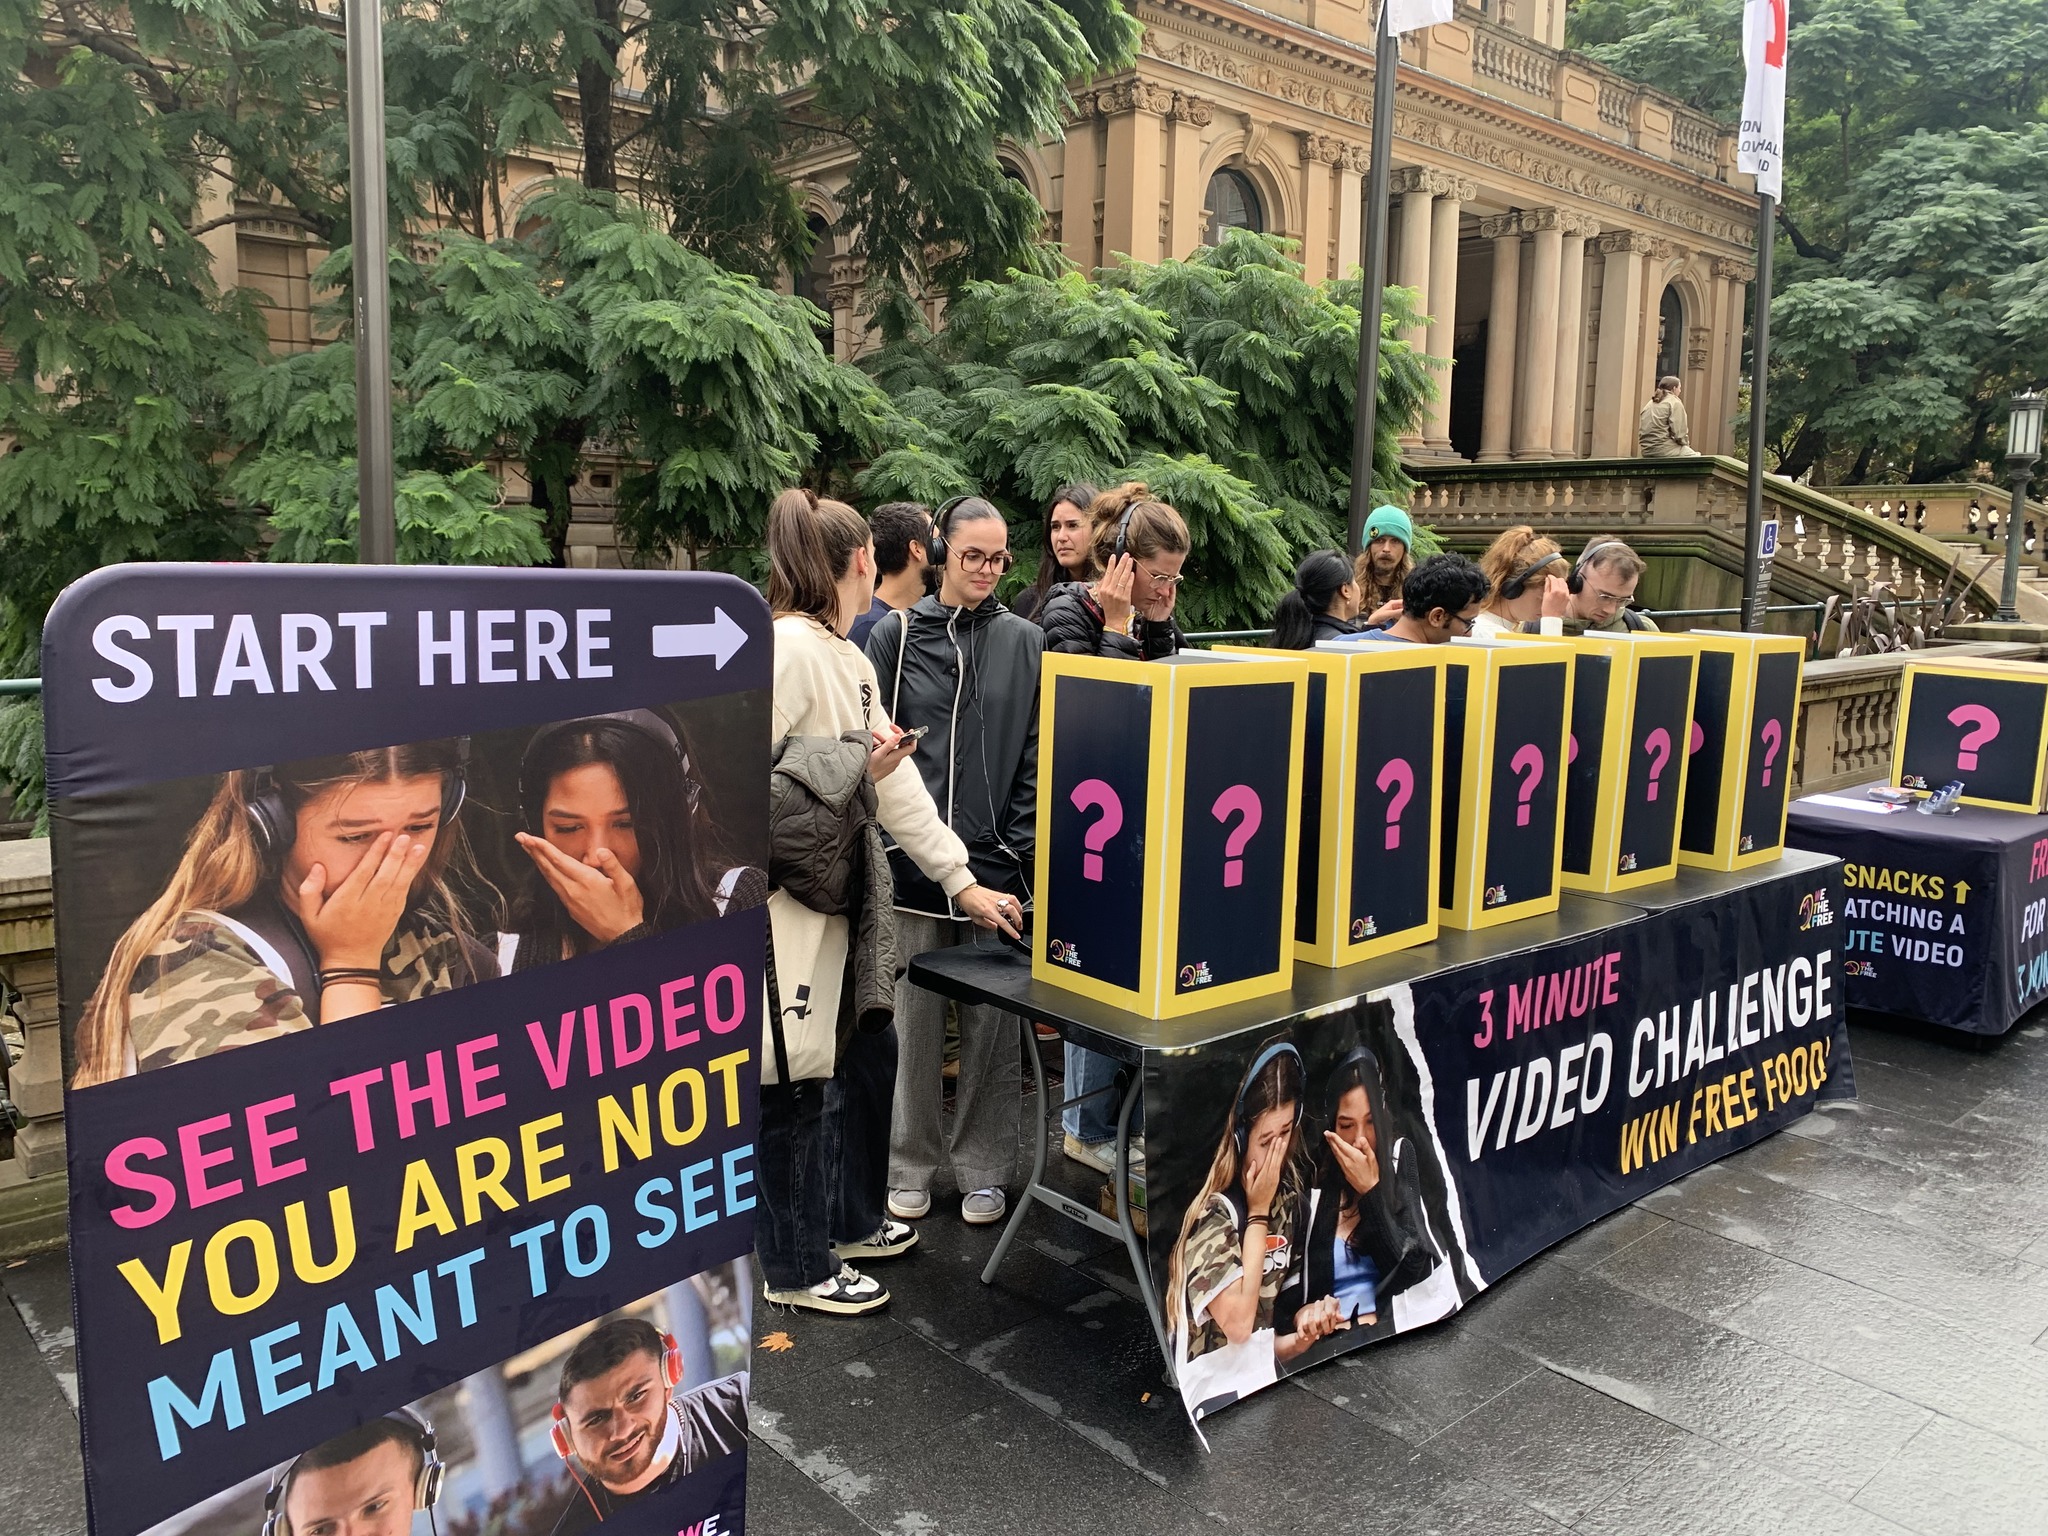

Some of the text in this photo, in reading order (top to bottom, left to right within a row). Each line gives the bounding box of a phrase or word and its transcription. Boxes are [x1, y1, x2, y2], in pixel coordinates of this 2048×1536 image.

[91, 608, 614, 704] START HERE
[2029, 838, 2048, 884] FR
[1814, 888, 1827, 902] WE
[1843, 863, 1945, 900] SNACKS
[1811, 911, 1834, 928] FREE
[1813, 899, 1830, 915] THE
[1948, 913, 1966, 935] A
[2021, 897, 2047, 944] FOR
[1064, 957, 1082, 968] FREE
[1065, 942, 1076, 951] WE
[1065, 949, 1079, 960] THE
[1891, 934, 1964, 968] VIDEO
[1195, 961, 1207, 970] WE
[1195, 967, 1210, 978] THE
[1195, 975, 1213, 985] FREE
[1473, 951, 1622, 1049] 3 MINUTE
[1466, 949, 1833, 1163] VIDEO CHALLENGE
[104, 963, 746, 1229] SEE THE VIDEO
[1619, 1099, 1681, 1175] WIN
[1687, 1067, 1759, 1145] FREE
[117, 1049, 750, 1345] YOU ARE NOT
[146, 1143, 757, 1461] MEANT TO SEE
